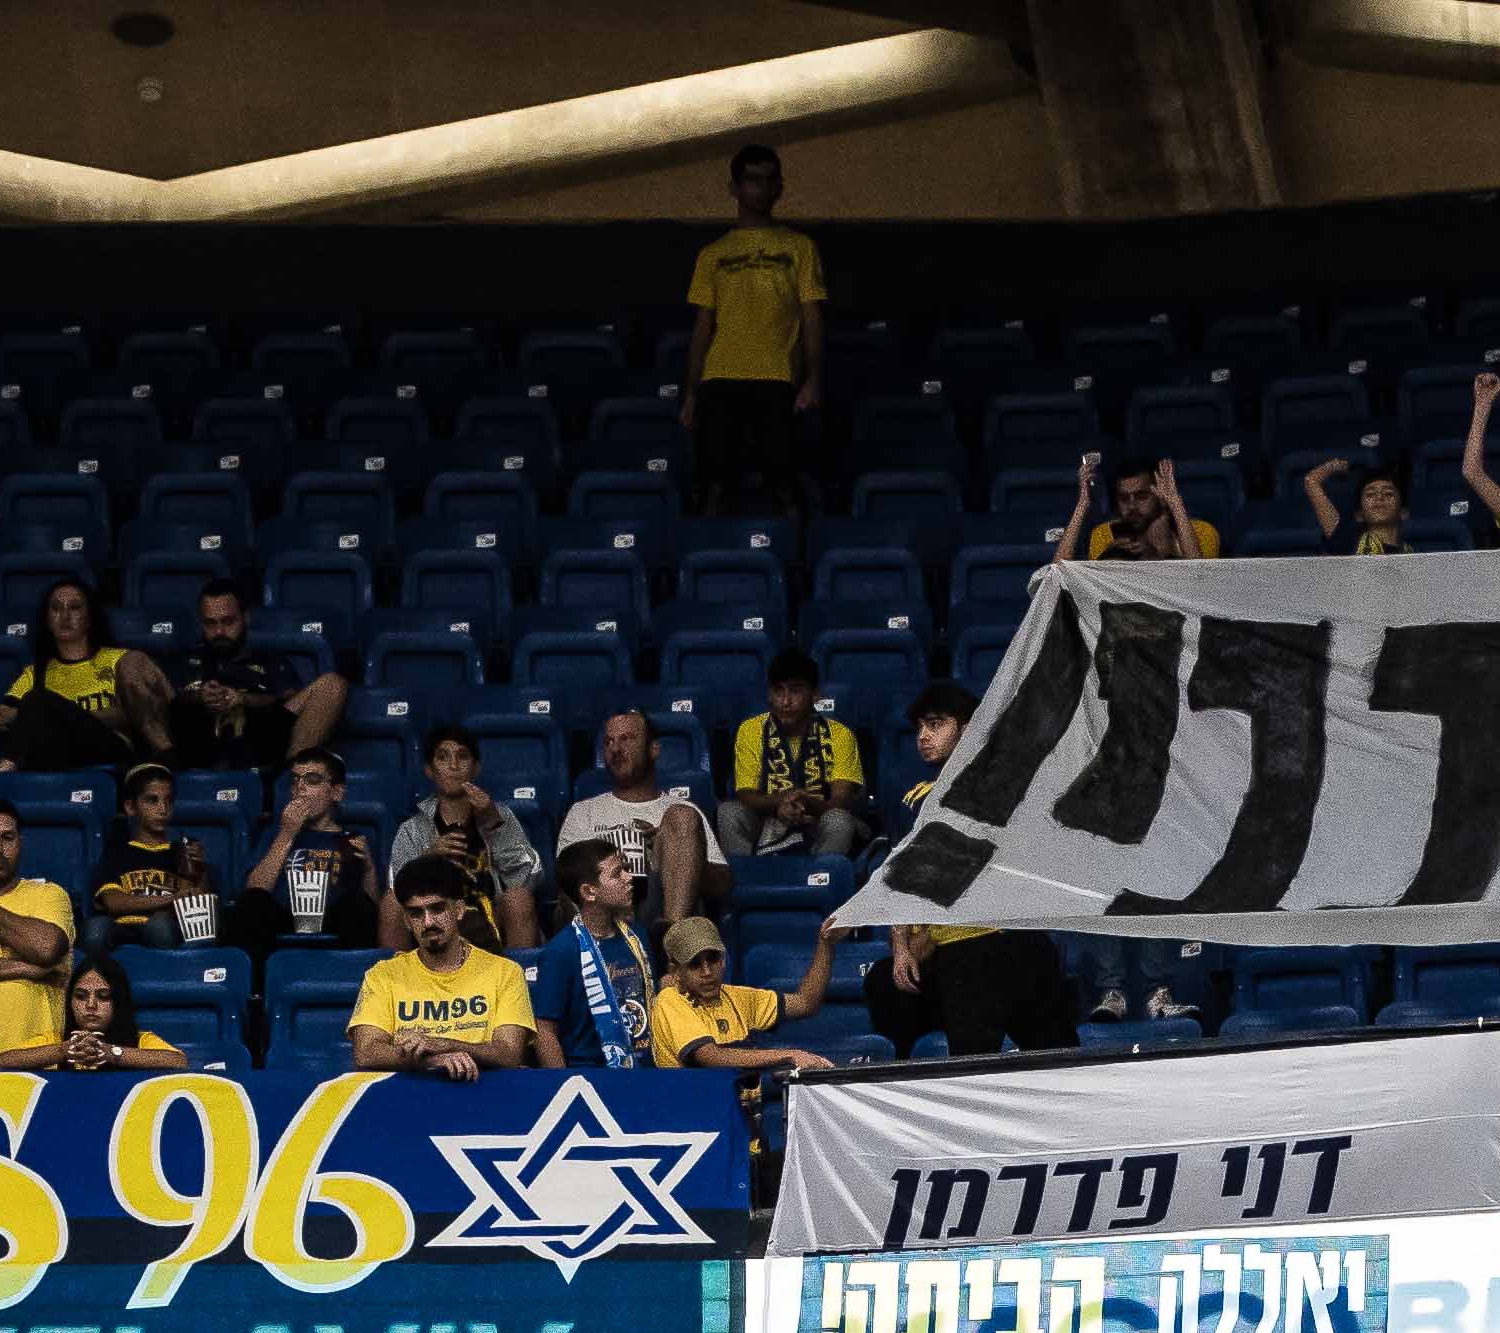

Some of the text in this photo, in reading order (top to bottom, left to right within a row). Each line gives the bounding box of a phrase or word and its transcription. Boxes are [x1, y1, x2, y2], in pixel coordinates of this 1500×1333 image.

[397, 993, 488, 1024] UM96
[108, 1070, 415, 1311] 96
[881, 1133, 1352, 1249] דני פדרמן
